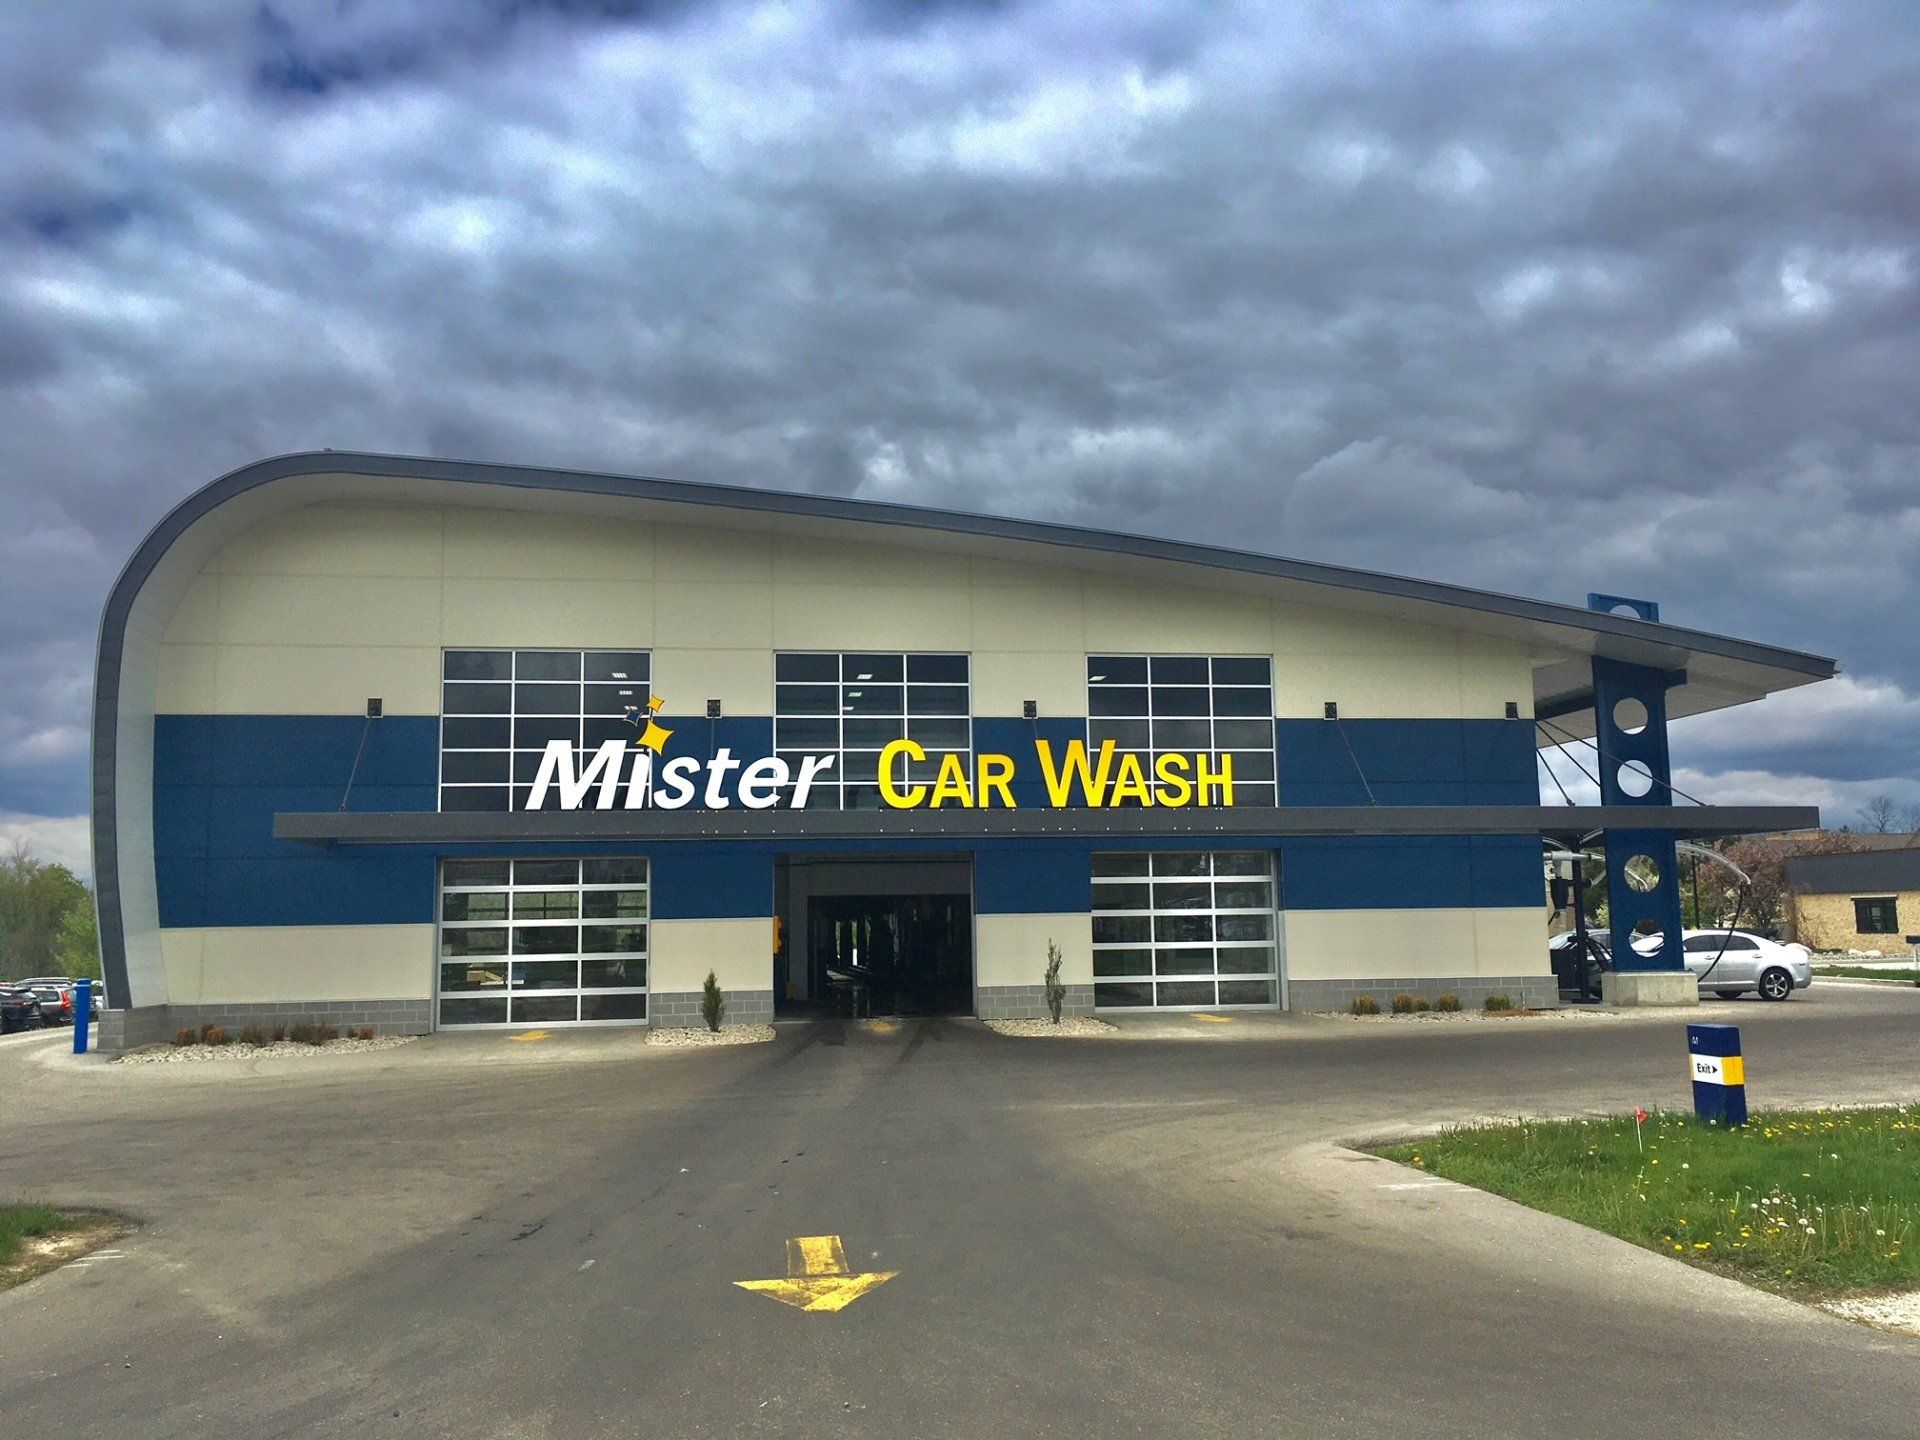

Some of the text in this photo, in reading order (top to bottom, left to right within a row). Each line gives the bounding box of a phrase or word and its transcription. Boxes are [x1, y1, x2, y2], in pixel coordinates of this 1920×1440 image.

[525, 719, 1233, 810] Mister CAR WASH
[1697, 1063, 1711, 1074] Exit
